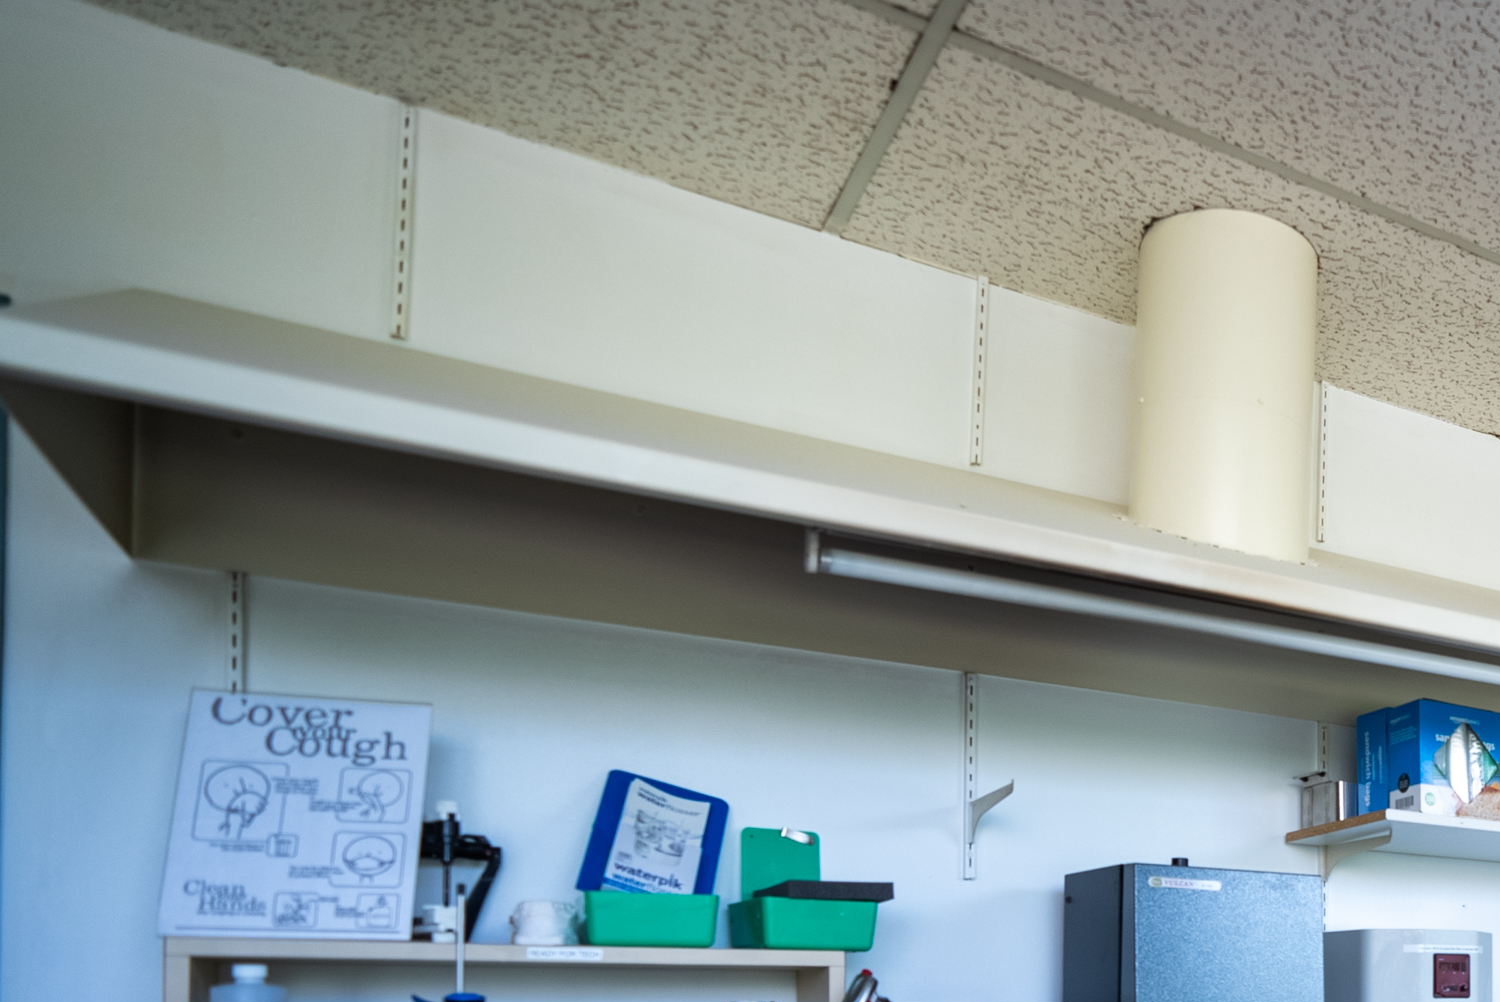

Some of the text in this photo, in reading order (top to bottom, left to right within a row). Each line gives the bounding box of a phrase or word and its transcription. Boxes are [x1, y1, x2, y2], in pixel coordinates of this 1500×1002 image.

[211, 696, 354, 727] Cover
[265, 727, 408, 767] Cough
[183, 879, 247, 899] Clean
[614, 862, 683, 891] waterpik
